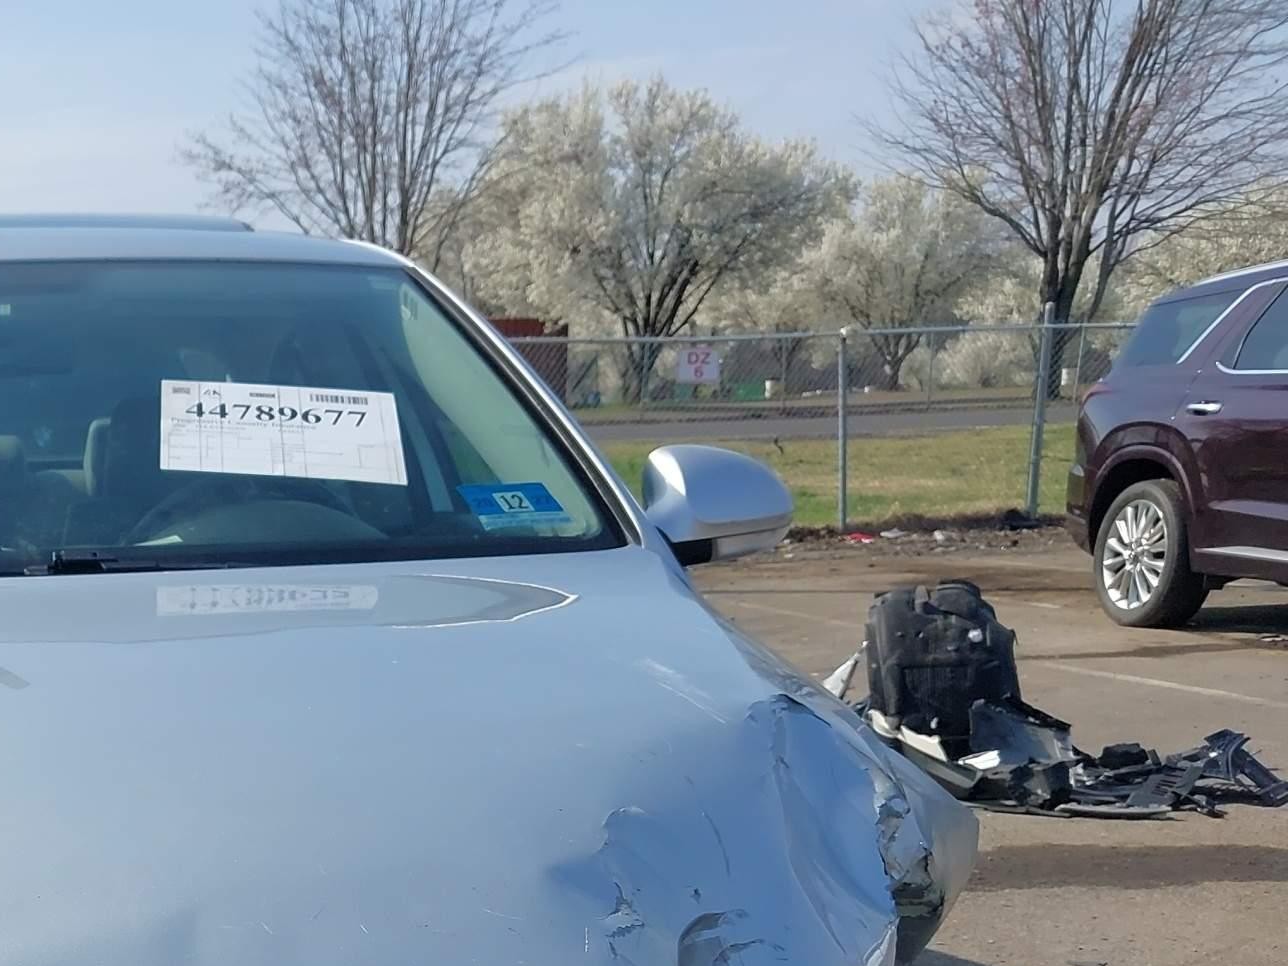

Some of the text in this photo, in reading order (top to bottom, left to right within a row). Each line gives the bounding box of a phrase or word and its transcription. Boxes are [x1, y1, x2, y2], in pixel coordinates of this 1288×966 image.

[687, 351, 711, 365] DZ
[694, 366, 703, 378] 6
[185, 401, 368, 428] 44789677
[500, 495, 530, 509] 12
